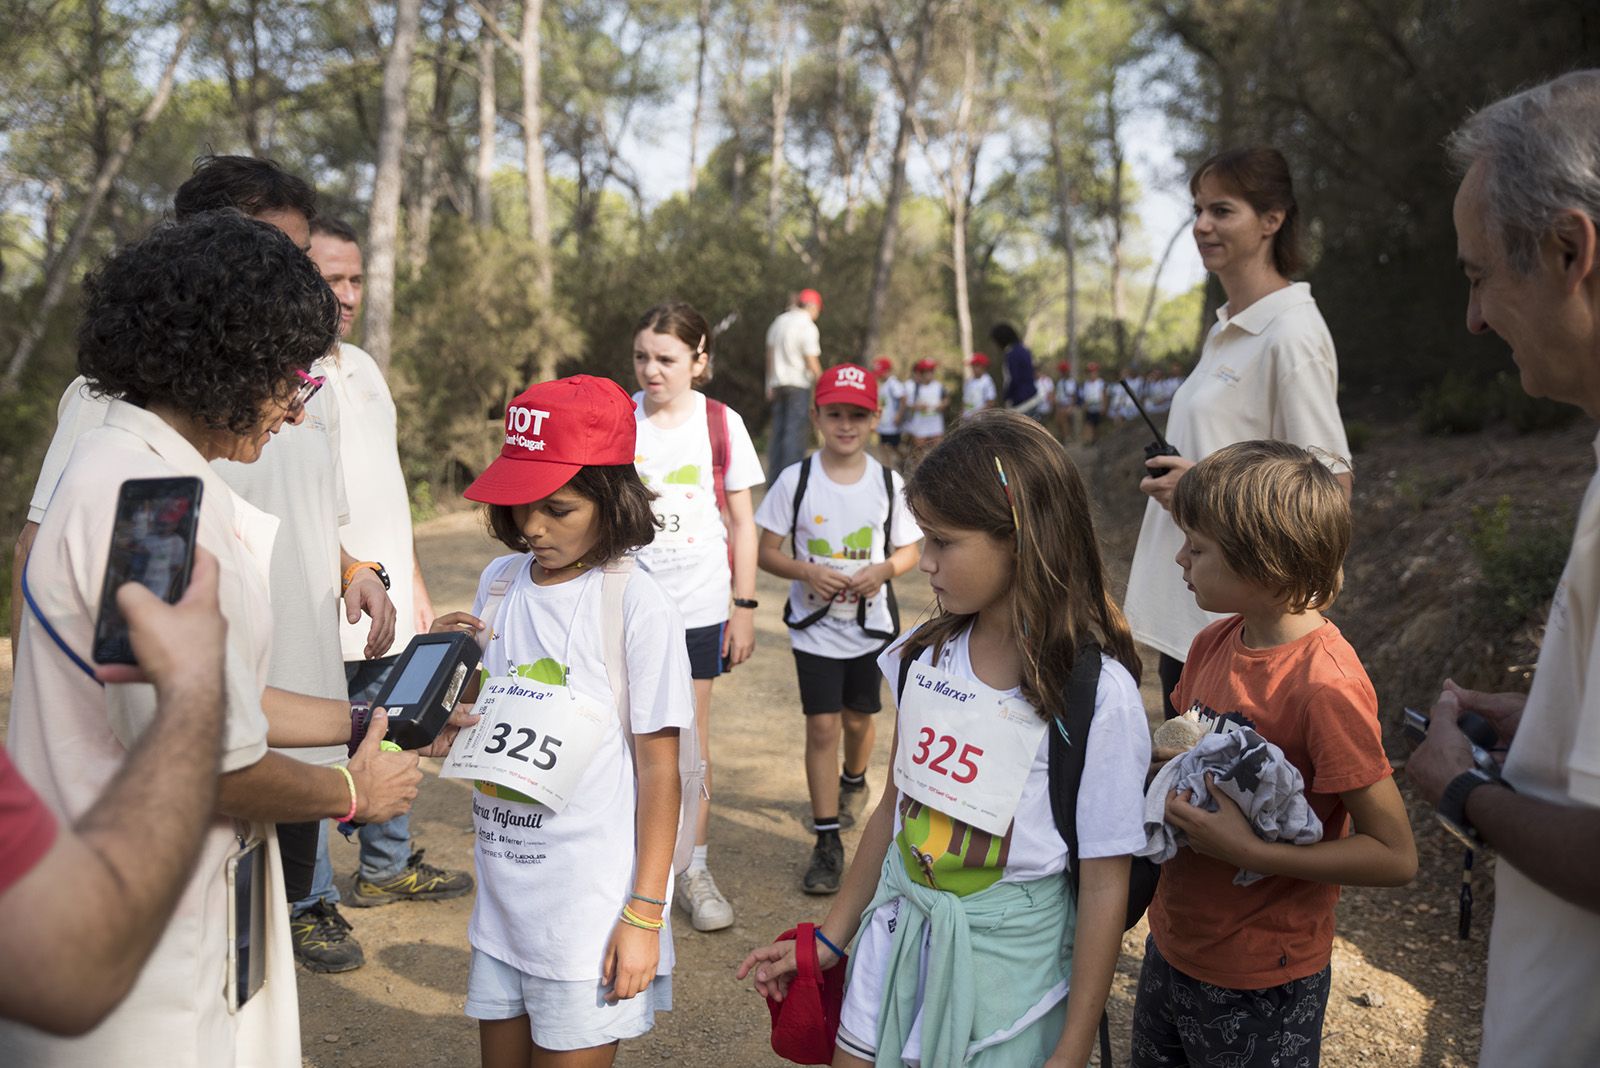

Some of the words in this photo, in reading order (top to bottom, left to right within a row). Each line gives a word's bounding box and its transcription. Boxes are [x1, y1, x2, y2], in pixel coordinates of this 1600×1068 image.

[837, 366, 866, 383] TOT
[508, 406, 550, 436] TOT
[519, 436, 546, 451] Cugat
[489, 685, 504, 694] “La
[507, 685, 553, 700] Marxa”
[915, 673, 933, 689] “La
[934, 680, 976, 703] Marxa”
[484, 722, 562, 771] 325
[912, 726, 984, 784] 325
[492, 807, 543, 829] Infantil
